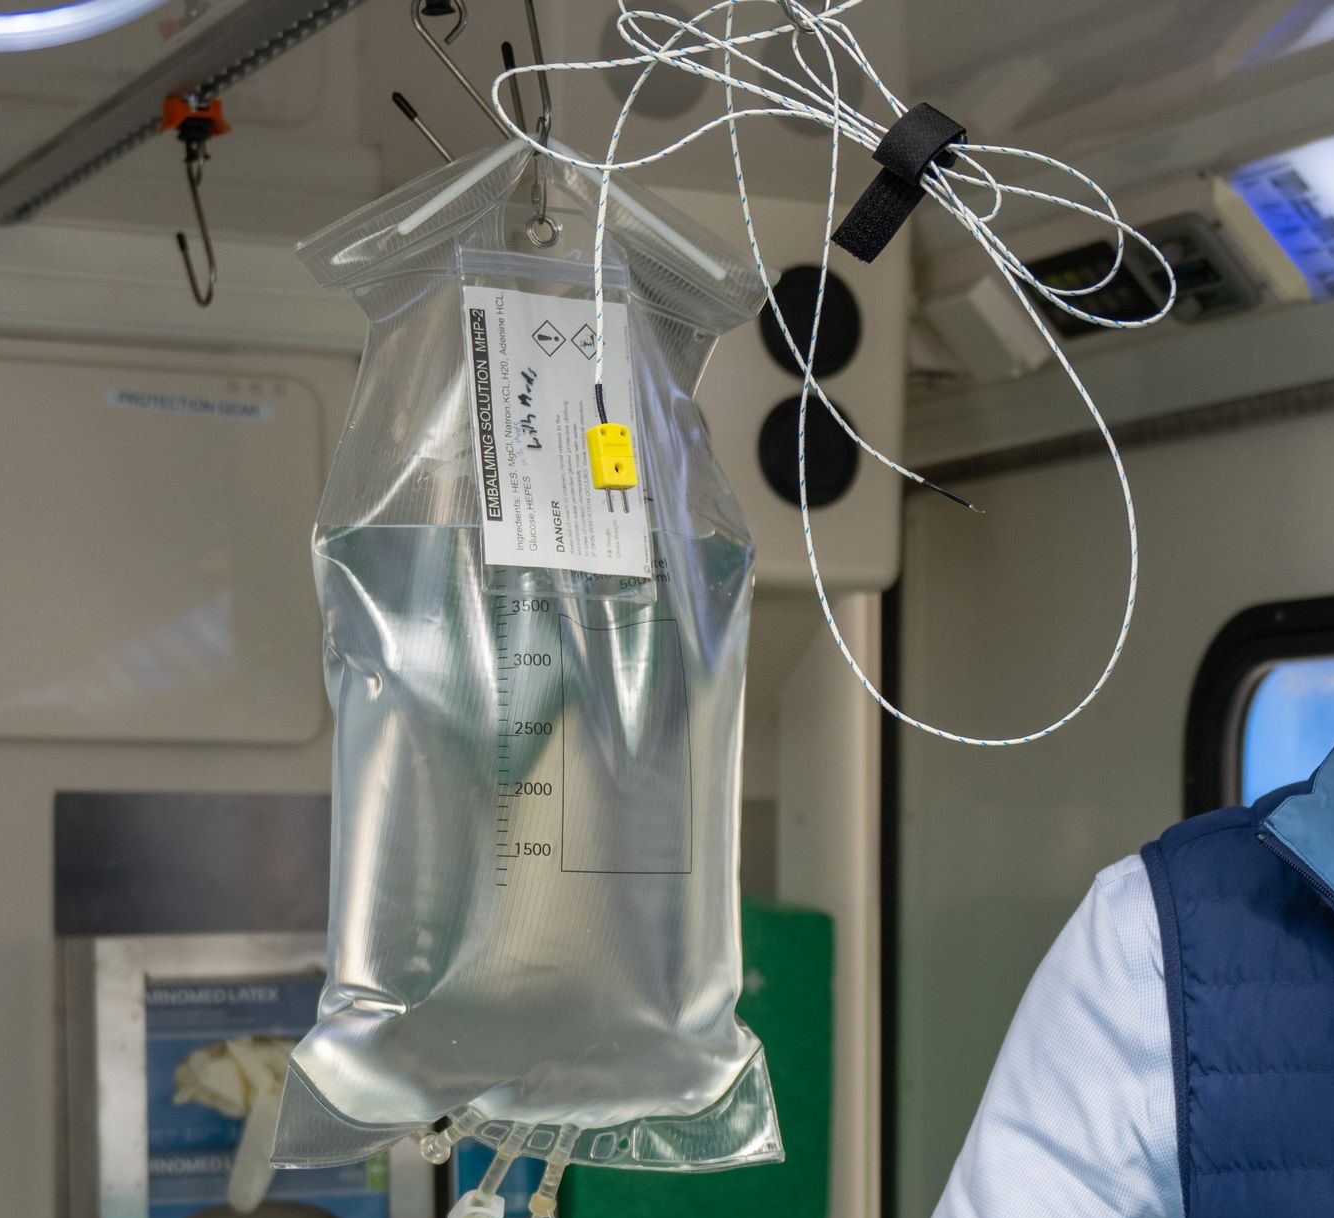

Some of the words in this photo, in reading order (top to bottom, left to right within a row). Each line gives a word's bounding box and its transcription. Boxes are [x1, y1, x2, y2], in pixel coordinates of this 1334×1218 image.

[473, 308, 485, 351] MHP-2
[497, 317, 506, 355] Adenine
[119, 391, 215, 414] PROTECTION
[476, 359, 491, 431] SOLUTION
[483, 434, 499, 517] EMBALMING
[512, 495, 524, 550] Ingredients:
[552, 499, 563, 552] DANGER
[512, 600, 550, 612] 3500
[513, 653, 552, 667] 3000
[515, 722, 553, 736] 2500
[515, 782, 553, 796] 2000
[515, 842, 552, 856] 1500
[229, 986, 280, 1003] LATEX
[149, 1157, 223, 1174] RNOMED
